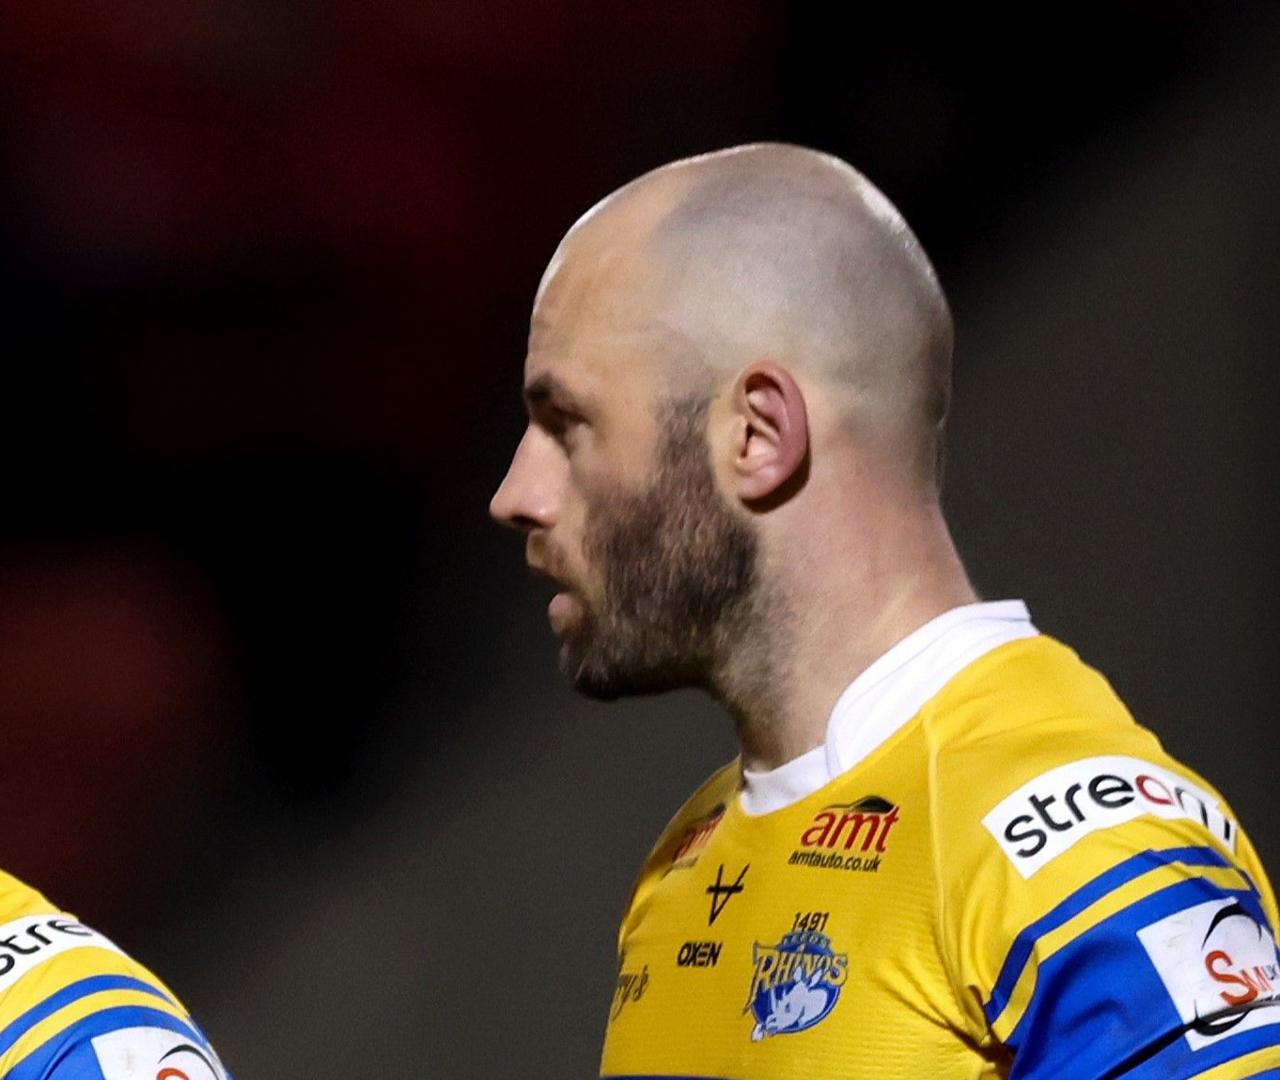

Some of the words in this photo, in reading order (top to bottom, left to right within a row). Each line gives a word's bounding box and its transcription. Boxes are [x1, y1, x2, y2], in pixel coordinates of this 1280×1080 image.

[800, 806, 900, 853] amt
[787, 850, 882, 873] amtauto.co.uk
[791, 912, 829, 933] 1491
[676, 941, 723, 967] OXEN
